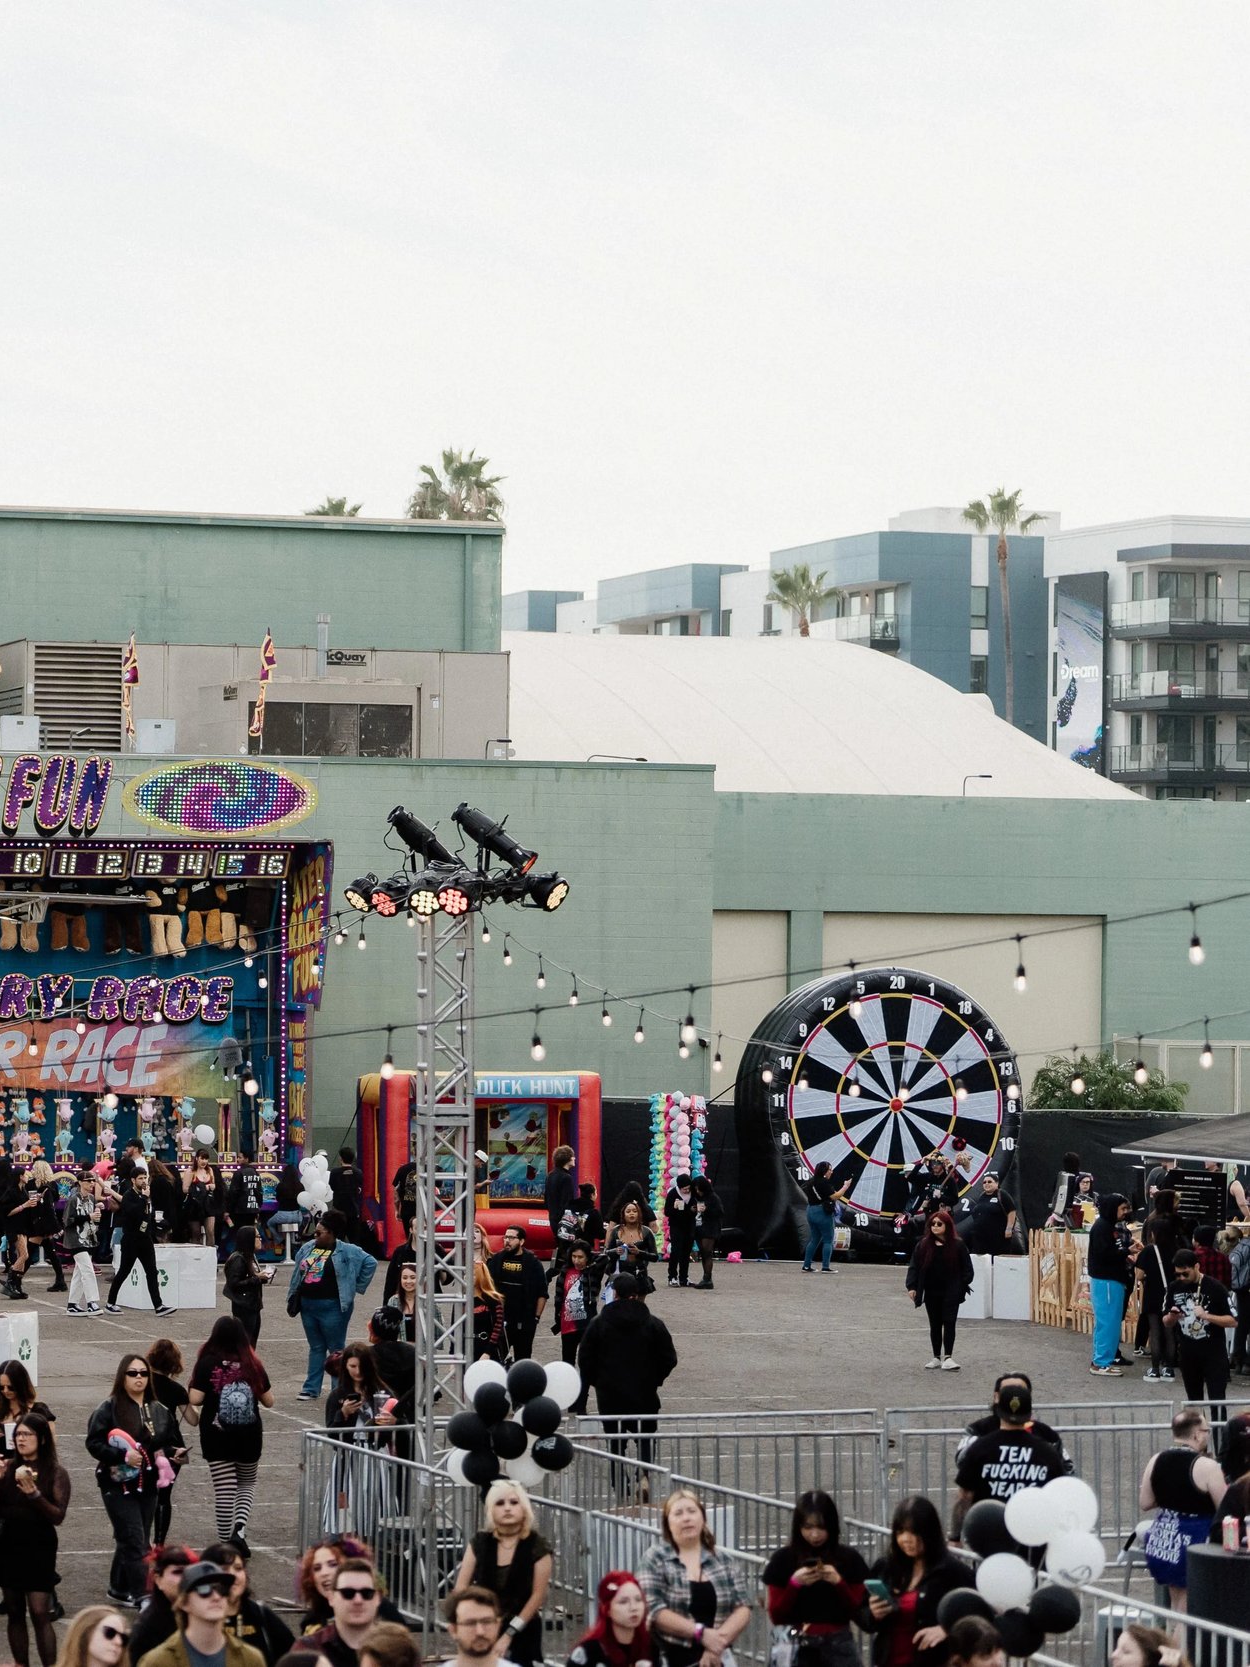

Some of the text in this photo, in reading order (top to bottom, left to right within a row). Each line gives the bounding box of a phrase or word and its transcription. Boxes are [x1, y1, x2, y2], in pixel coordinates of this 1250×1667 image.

[1060, 664, 1099, 680] Dream
[2, 754, 113, 833] FUN
[13, 853, 42, 874] 10
[58, 853, 78, 874] 11
[95, 854, 123, 875] 12
[137, 854, 163, 875] 13
[177, 854, 205, 875] 14
[216, 854, 246, 875] 15
[258, 855, 284, 875] 16
[291, 855, 326, 911] ATER
[856, 981, 865, 995] 5
[890, 975, 905, 990] 20
[928, 983, 935, 997] 1
[87, 975, 235, 1023] RACE
[821, 997, 836, 1011] 12
[958, 1001, 972, 1015] 18
[799, 1023, 808, 1037] 9
[985, 1028, 994, 1042] 4
[40, 1024, 170, 1089] RACE
[779, 1057, 792, 1070] 14
[999, 1062, 1013, 1076] 13
[477, 1079, 576, 1096] DUCK HUNT
[772, 1095, 785, 1107] 11
[1007, 1100, 1016, 1113] 6
[781, 1132, 790, 1146] 8
[999, 1137, 1014, 1151] 10
[796, 1167, 809, 1181] 16
[961, 1198, 970, 1211] 2
[854, 1213, 869, 1226] 19
[999, 1445, 1032, 1463] TEN
[981, 1463, 1048, 1481] FUCKING
